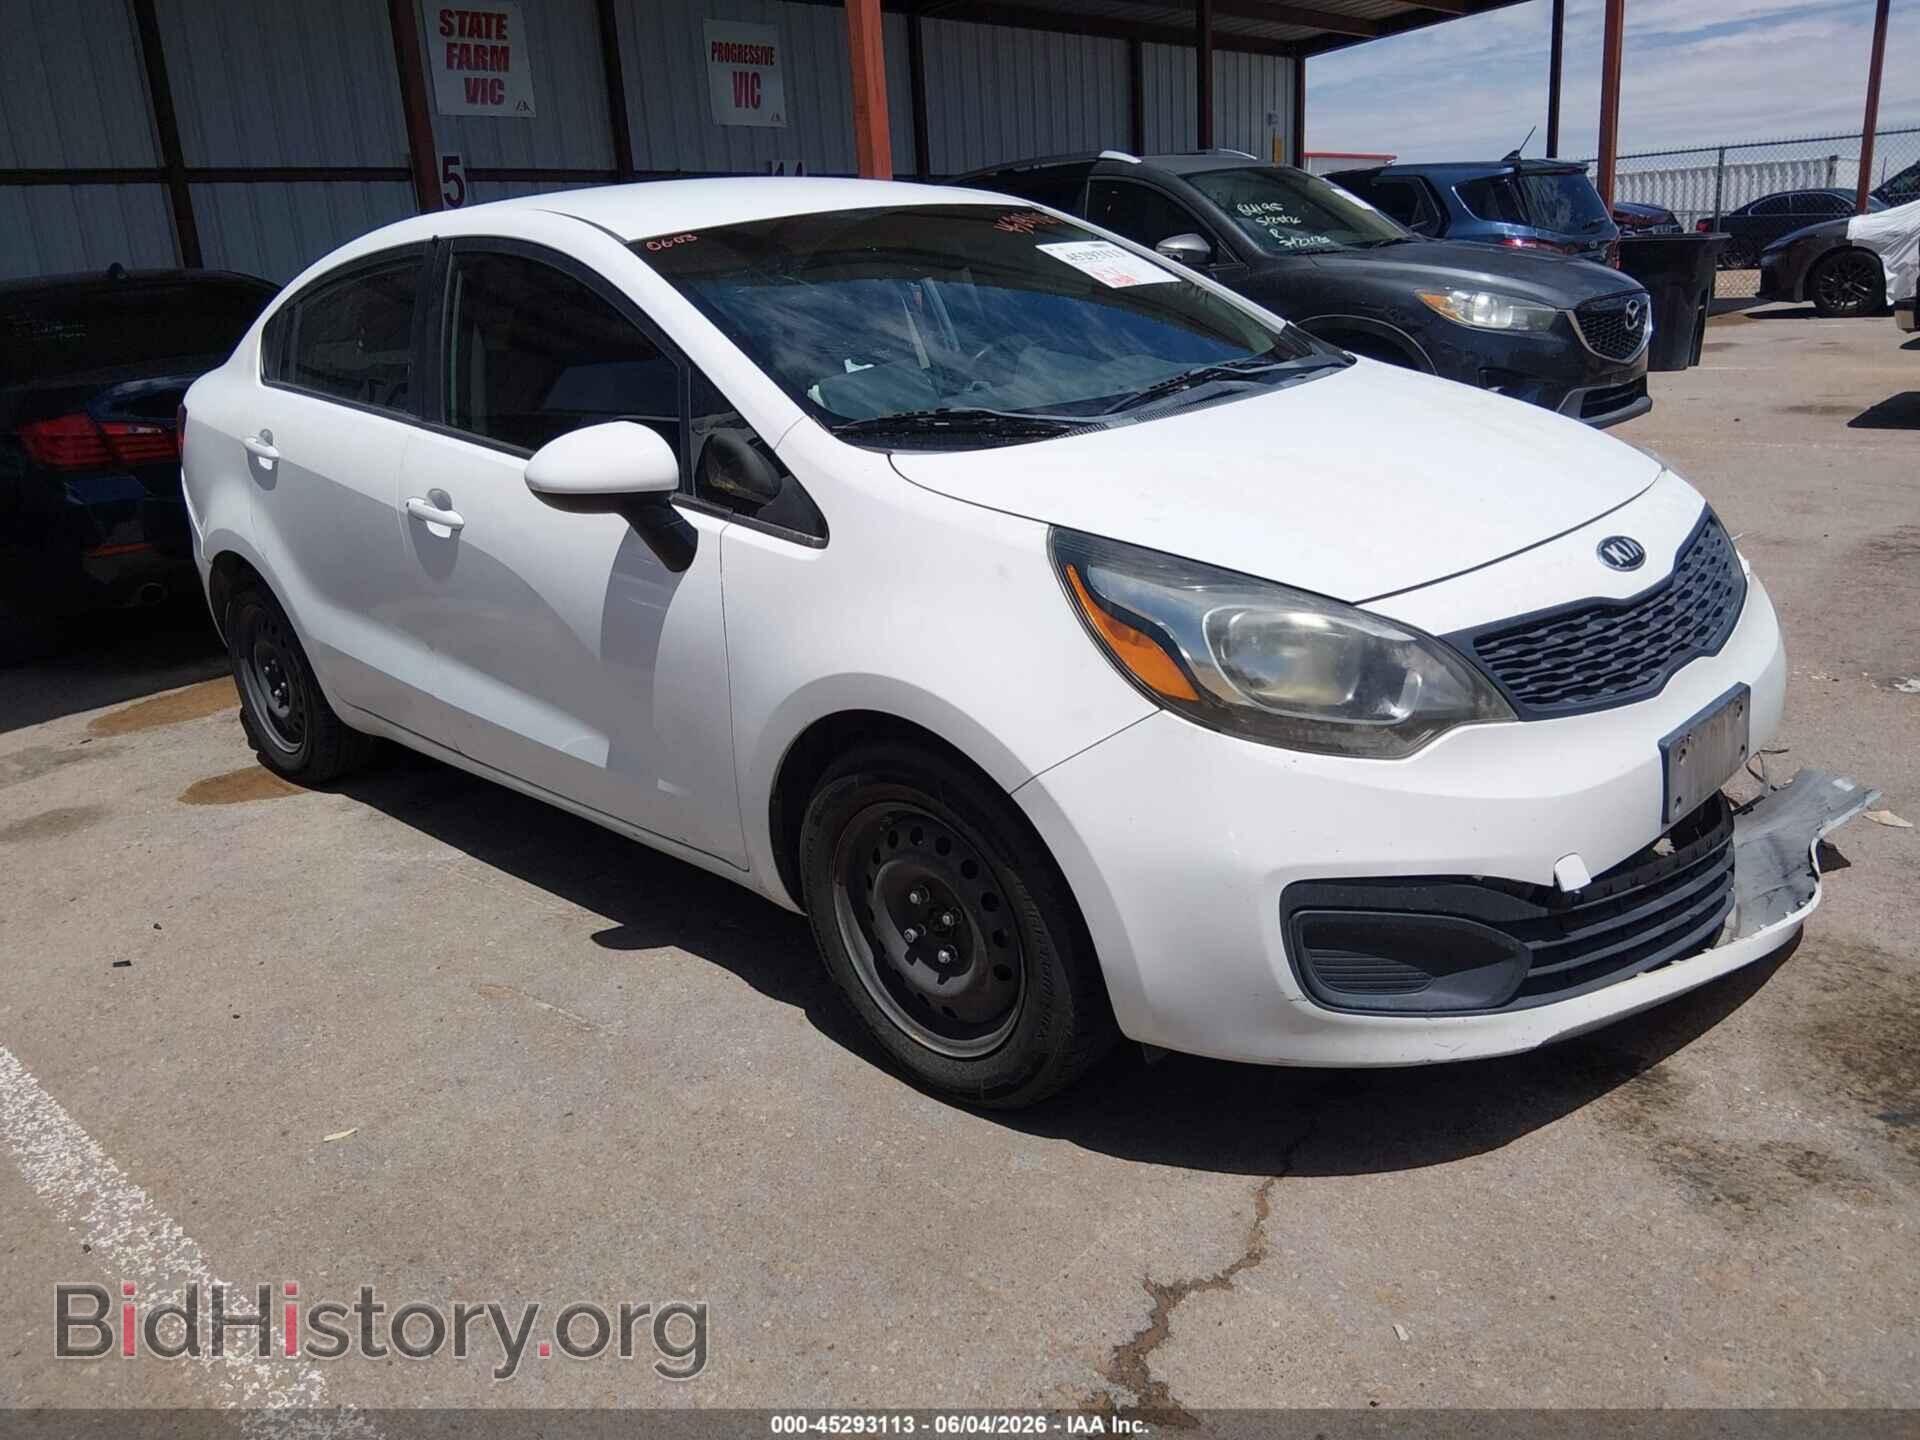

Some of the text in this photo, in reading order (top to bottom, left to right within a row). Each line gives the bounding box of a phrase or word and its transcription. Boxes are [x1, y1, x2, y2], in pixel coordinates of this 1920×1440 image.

[439, 9, 508, 41] STATE
[446, 42, 510, 72] FARM
[711, 41, 775, 66] PROGRESSIVE
[464, 77, 505, 105] VIC
[732, 71, 762, 110] VIC
[442, 156, 465, 208] 5
